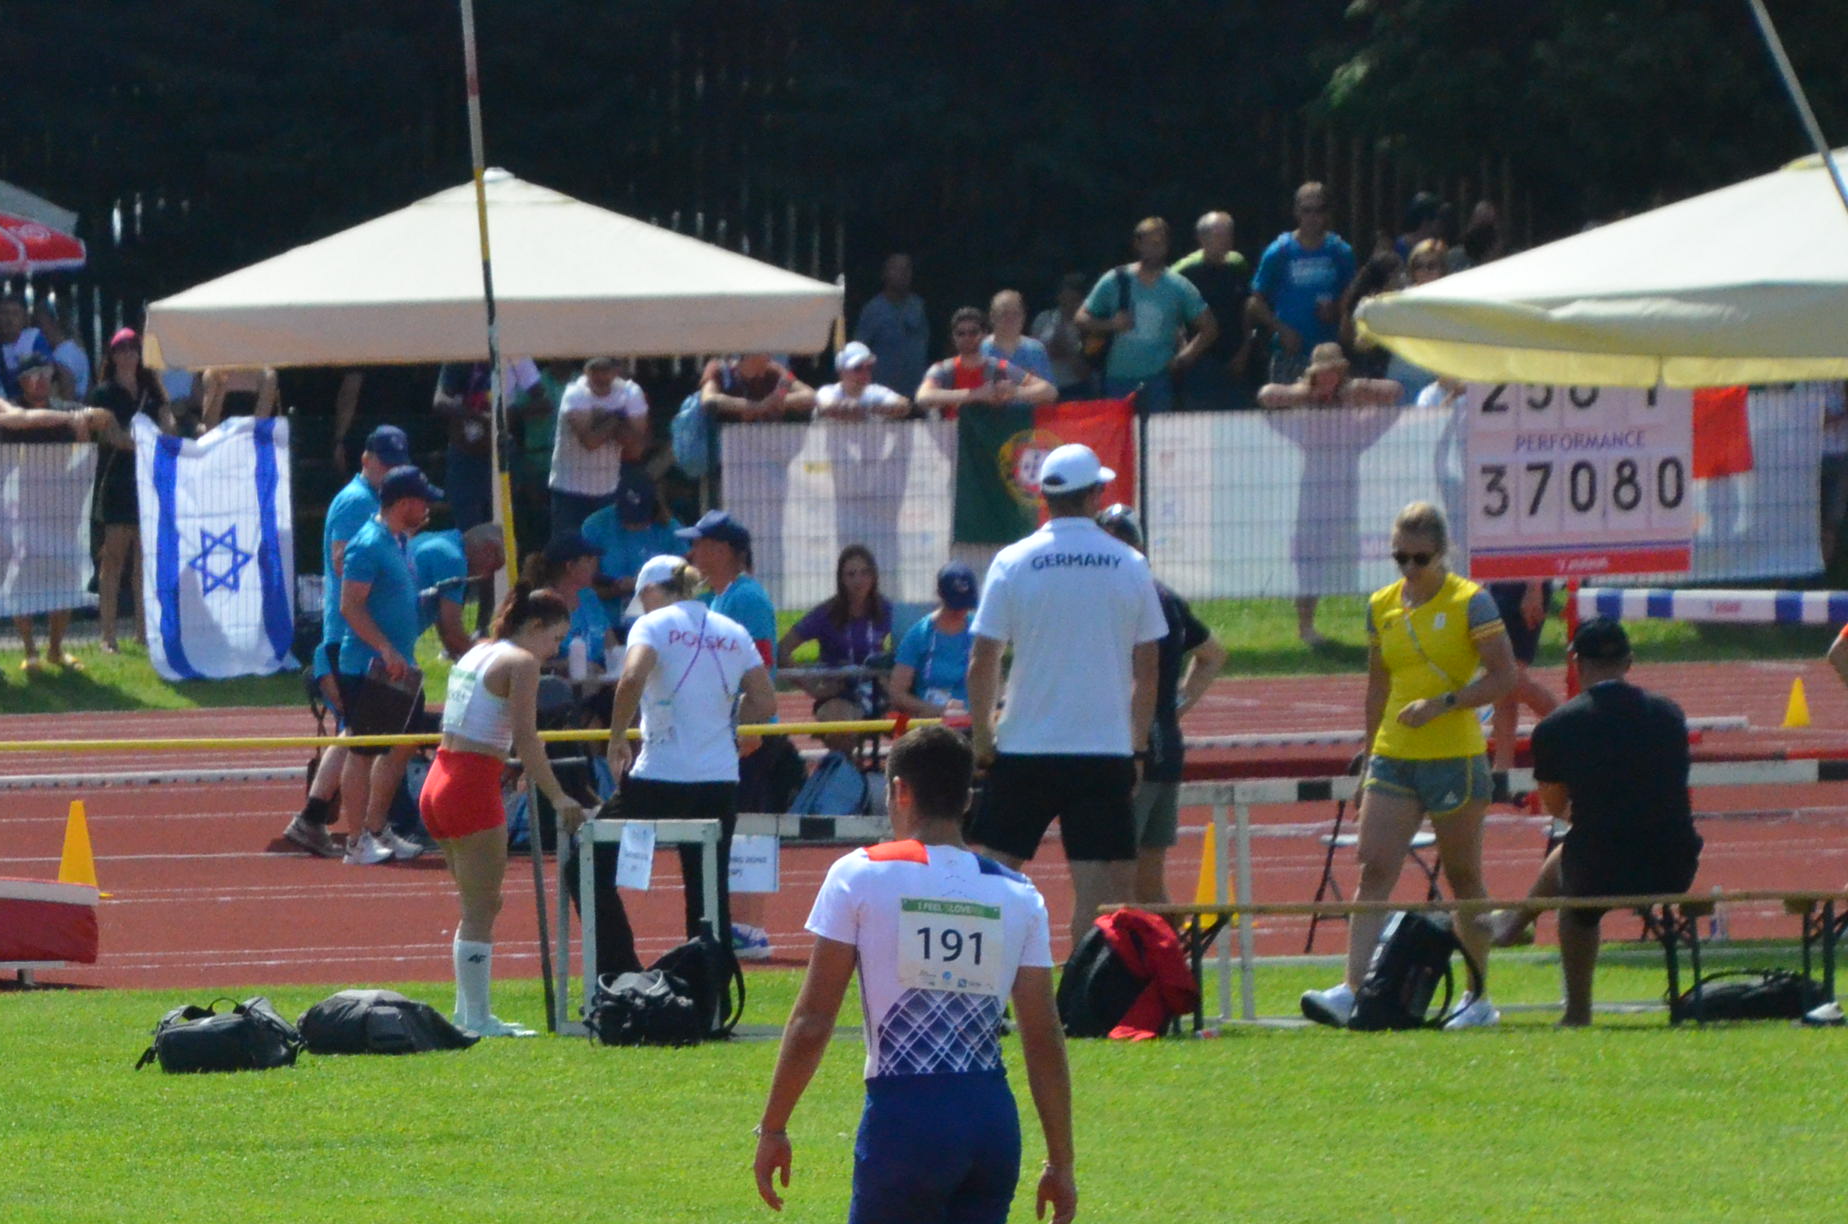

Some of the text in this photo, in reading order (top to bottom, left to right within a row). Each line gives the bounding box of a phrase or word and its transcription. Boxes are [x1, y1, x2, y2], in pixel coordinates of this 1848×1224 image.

[1515, 430, 1646, 452] PERFORMANCE
[1032, 553, 1122, 569] GERMANY
[917, 927, 983, 965] 191
